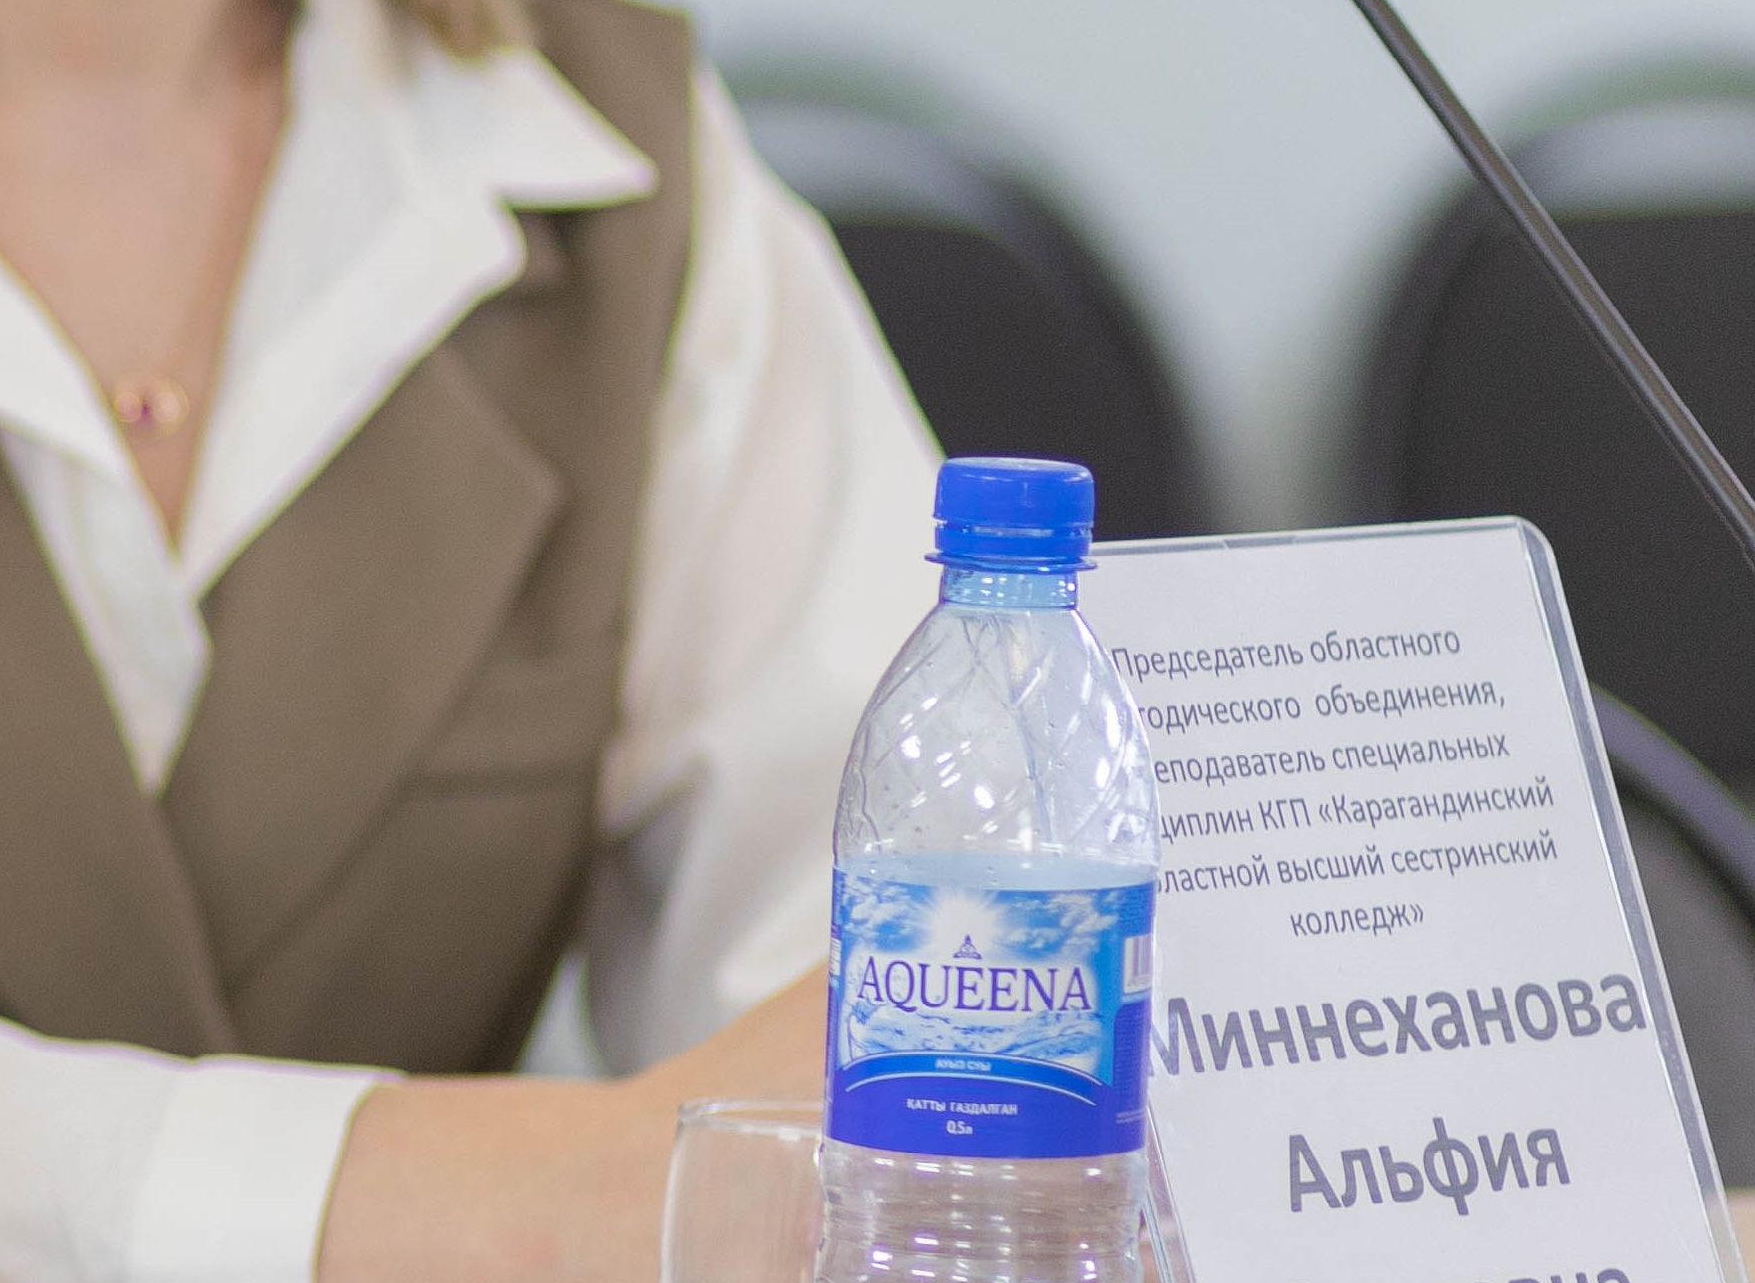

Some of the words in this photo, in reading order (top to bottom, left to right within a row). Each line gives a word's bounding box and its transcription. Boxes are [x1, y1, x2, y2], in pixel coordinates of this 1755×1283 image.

[1111, 642, 1304, 683] Председатель
[1310, 630, 1461, 663] областного
[1138, 696, 1301, 735] одического
[1315, 681, 1506, 719] объединения,
[1154, 748, 1326, 787] еподаватель
[1332, 734, 1510, 772] специальных
[1258, 797, 1312, 831] КГП
[1319, 775, 1554, 829] «Карагандинский
[1158, 853, 1271, 893] ластной
[1277, 844, 1385, 884] высший
[1391, 829, 1558, 876] сестринский
[1290, 903, 1424, 938] колледж»
[856, 955, 1094, 1013] AQUEENA
[1148, 974, 1648, 1077] Миннеханова
[1288, 1117, 1571, 1216] Альфия
